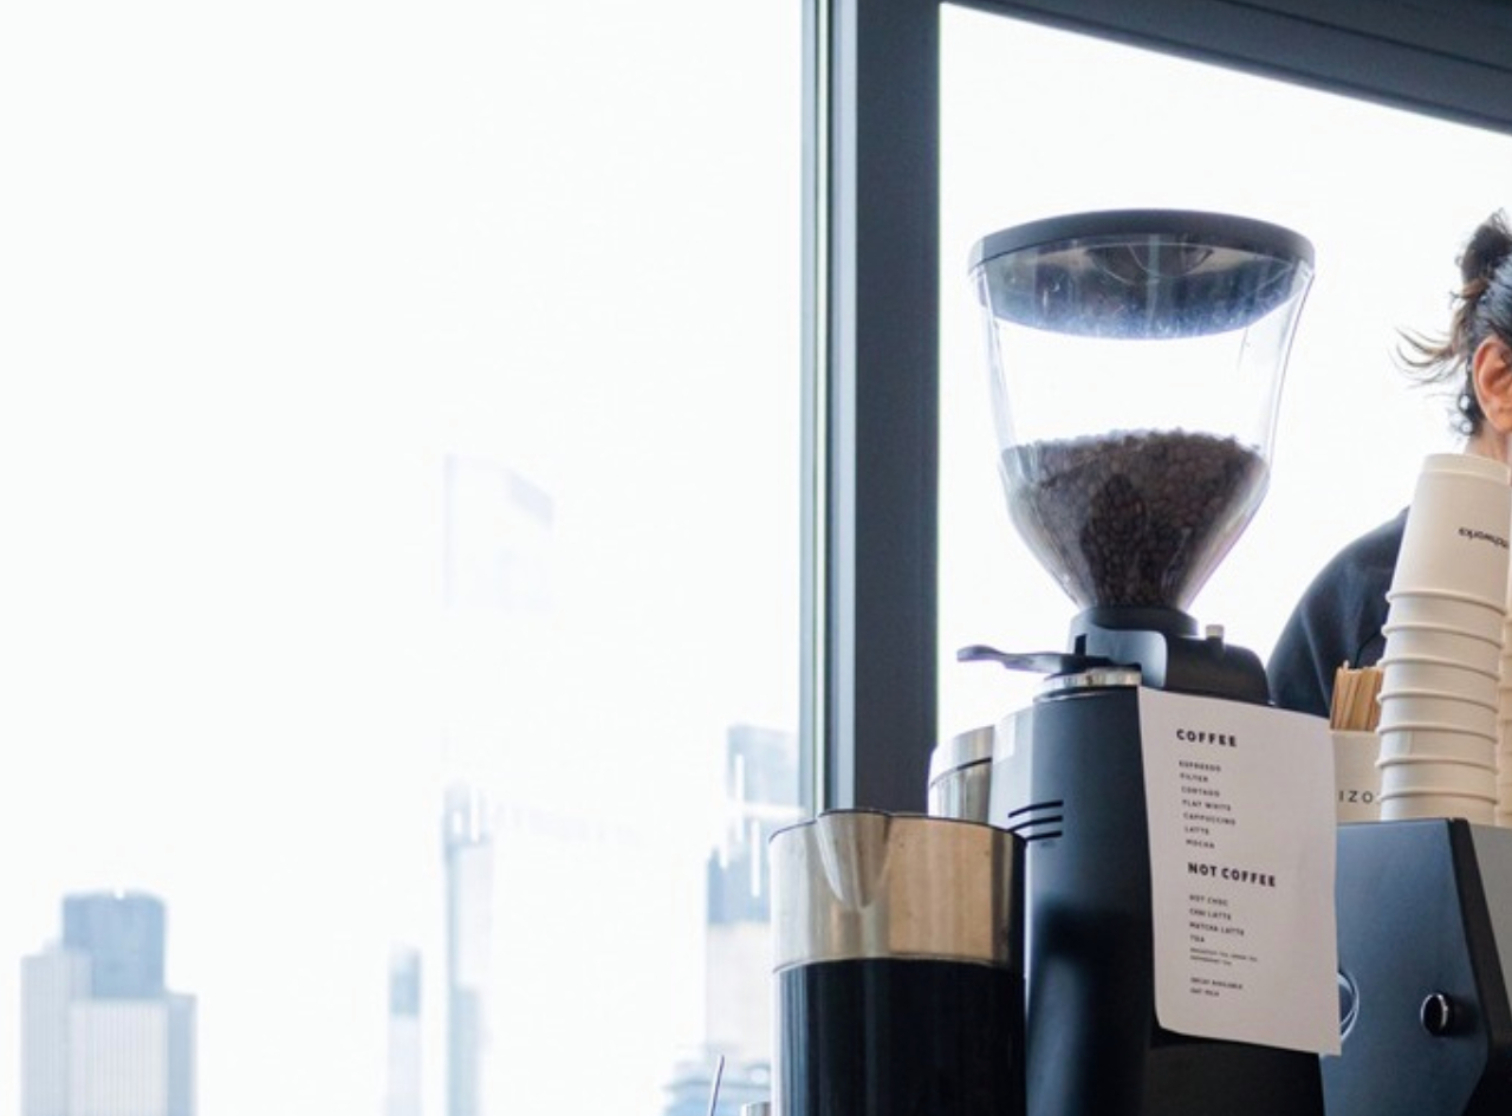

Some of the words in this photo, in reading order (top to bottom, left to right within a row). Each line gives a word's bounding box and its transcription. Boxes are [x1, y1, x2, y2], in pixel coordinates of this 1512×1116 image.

[1176, 728, 1237, 747] COFFEE
[1180, 772, 1208, 782] FILTER
[1183, 799, 1201, 807] FLAT
[1184, 826, 1210, 835] LATTE
[1187, 862, 1217, 877] NOT
[1221, 867, 1275, 887] COFFEE
